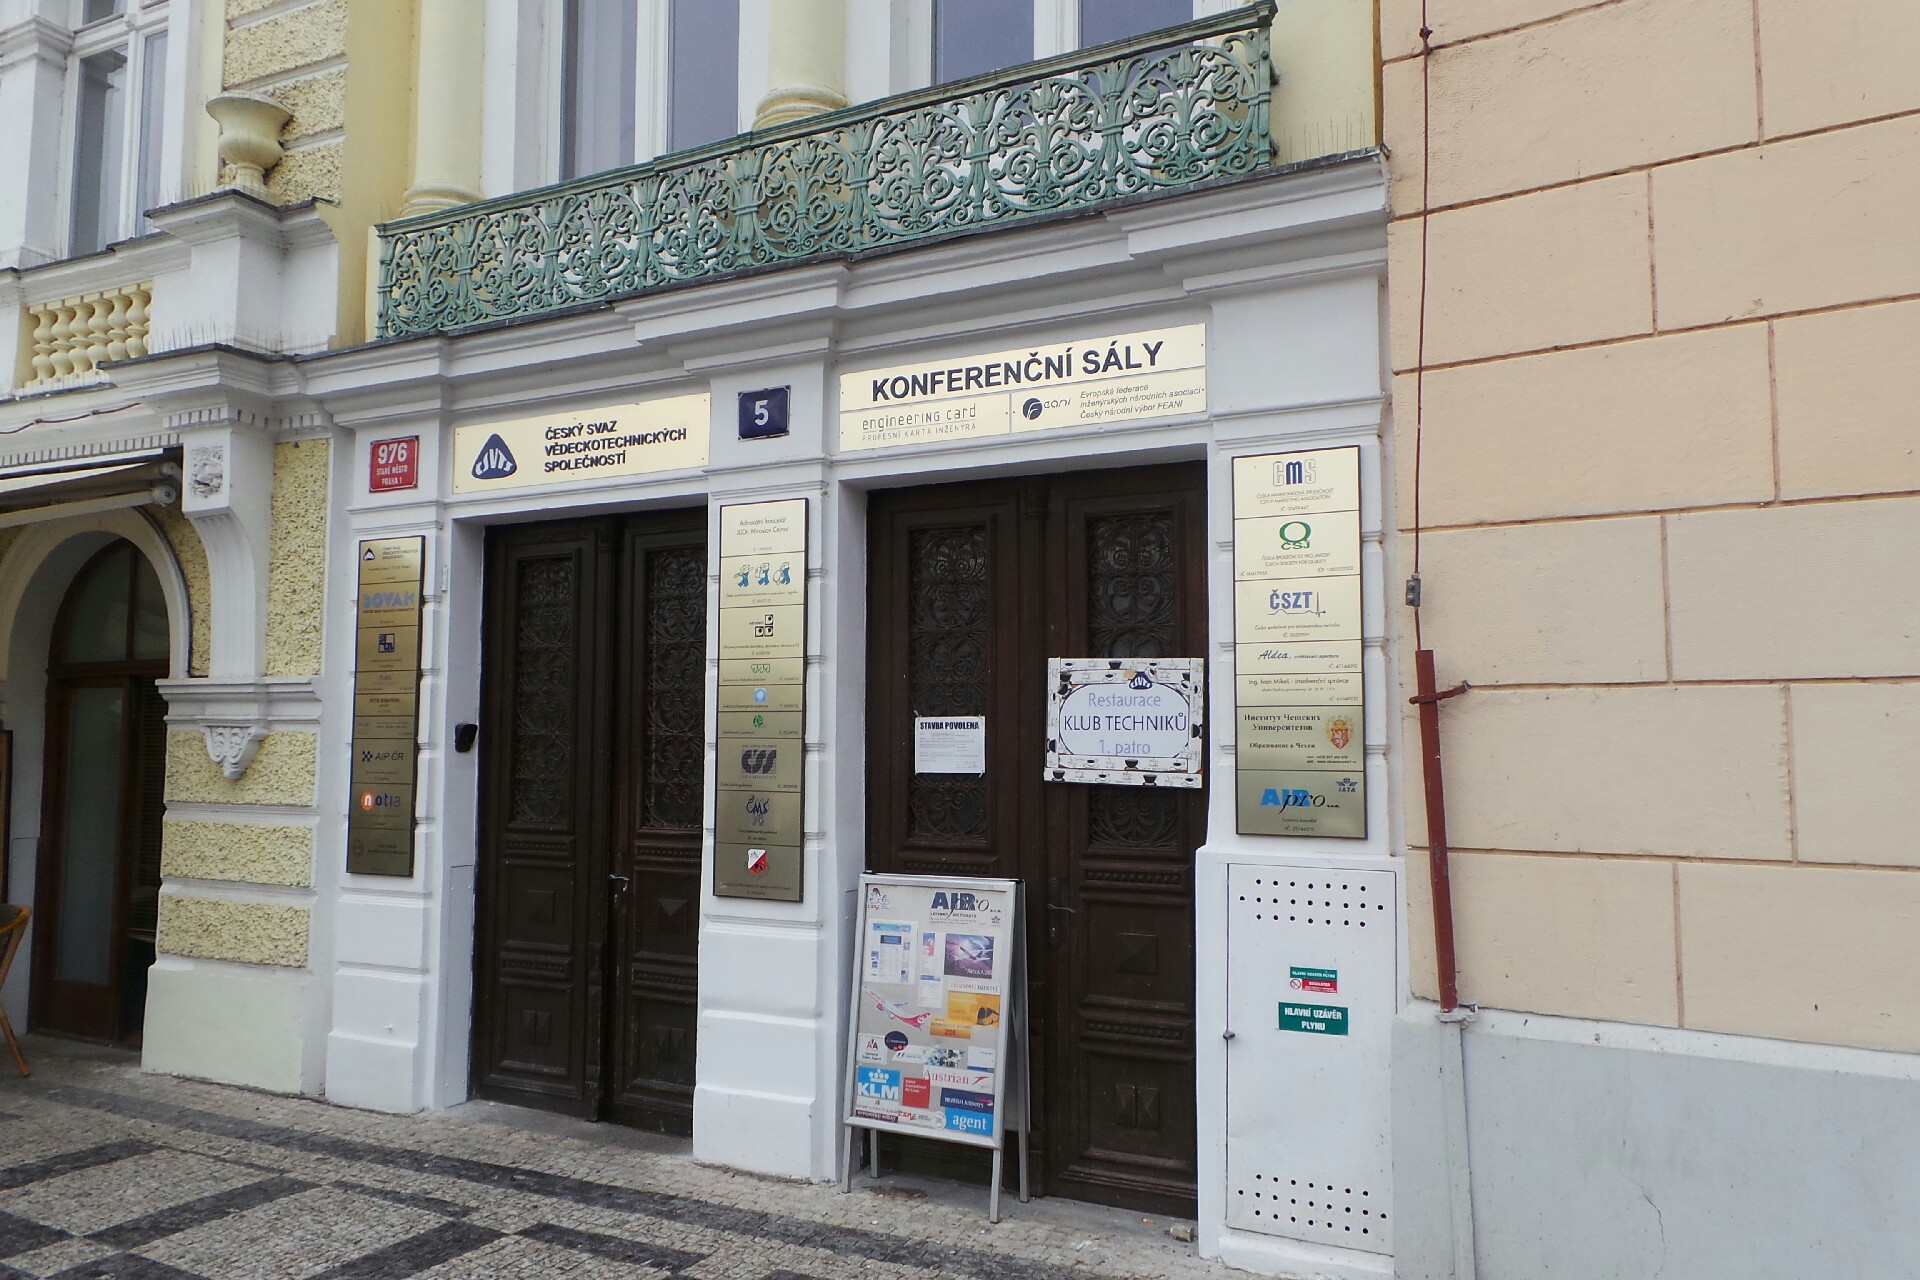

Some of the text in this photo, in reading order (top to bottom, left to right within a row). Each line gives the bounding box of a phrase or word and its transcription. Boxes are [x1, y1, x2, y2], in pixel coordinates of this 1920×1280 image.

[873, 340, 1164, 402] KONFERENČNÍ SÁLY
[1080, 386, 1202, 409] inženýrských národních asociací
[1116, 384, 1149, 394] federace
[755, 399, 769, 426] 5
[946, 402, 976, 421] card
[1080, 400, 1184, 419] Český národní výbor FEANI
[545, 420, 617, 441] ČESKÝ SVAZ
[862, 422, 976, 442] PROFESNÍ KARTA INŽENÝRA
[545, 427, 687, 457] VĚDECKOTECHNICKÝCH
[378, 442, 408, 465] 976
[544, 450, 626, 473] SPOLEČNOSTÍ
[376, 463, 408, 476] STARÉ MĚSTO
[381, 477, 399, 486] PRAHA
[1269, 588, 1313, 610] ČSZT
[1294, 677, 1326, 685] insolvenční
[1327, 678, 1350, 687] správce
[1088, 692, 1161, 707] Restaurace
[920, 721, 980, 730] STAVBA POVOLENA
[1064, 711, 1187, 731] KLUB TECHNIKŮ
[1244, 714, 1282, 723] Институт
[1252, 723, 1313, 733] Университетов
[1099, 739, 1151, 756] 1. patro
[1260, 788, 1312, 807] AIR
[930, 892, 976, 911] AIR
[1285, 1007, 1342, 1020] HLAVNÍ UZÁVĚR
[1301, 1020, 1326, 1031] PLYNU
[924, 1069, 970, 1085] Austrian
[857, 1082, 900, 1101] KLM
[952, 1115, 988, 1131] agent
